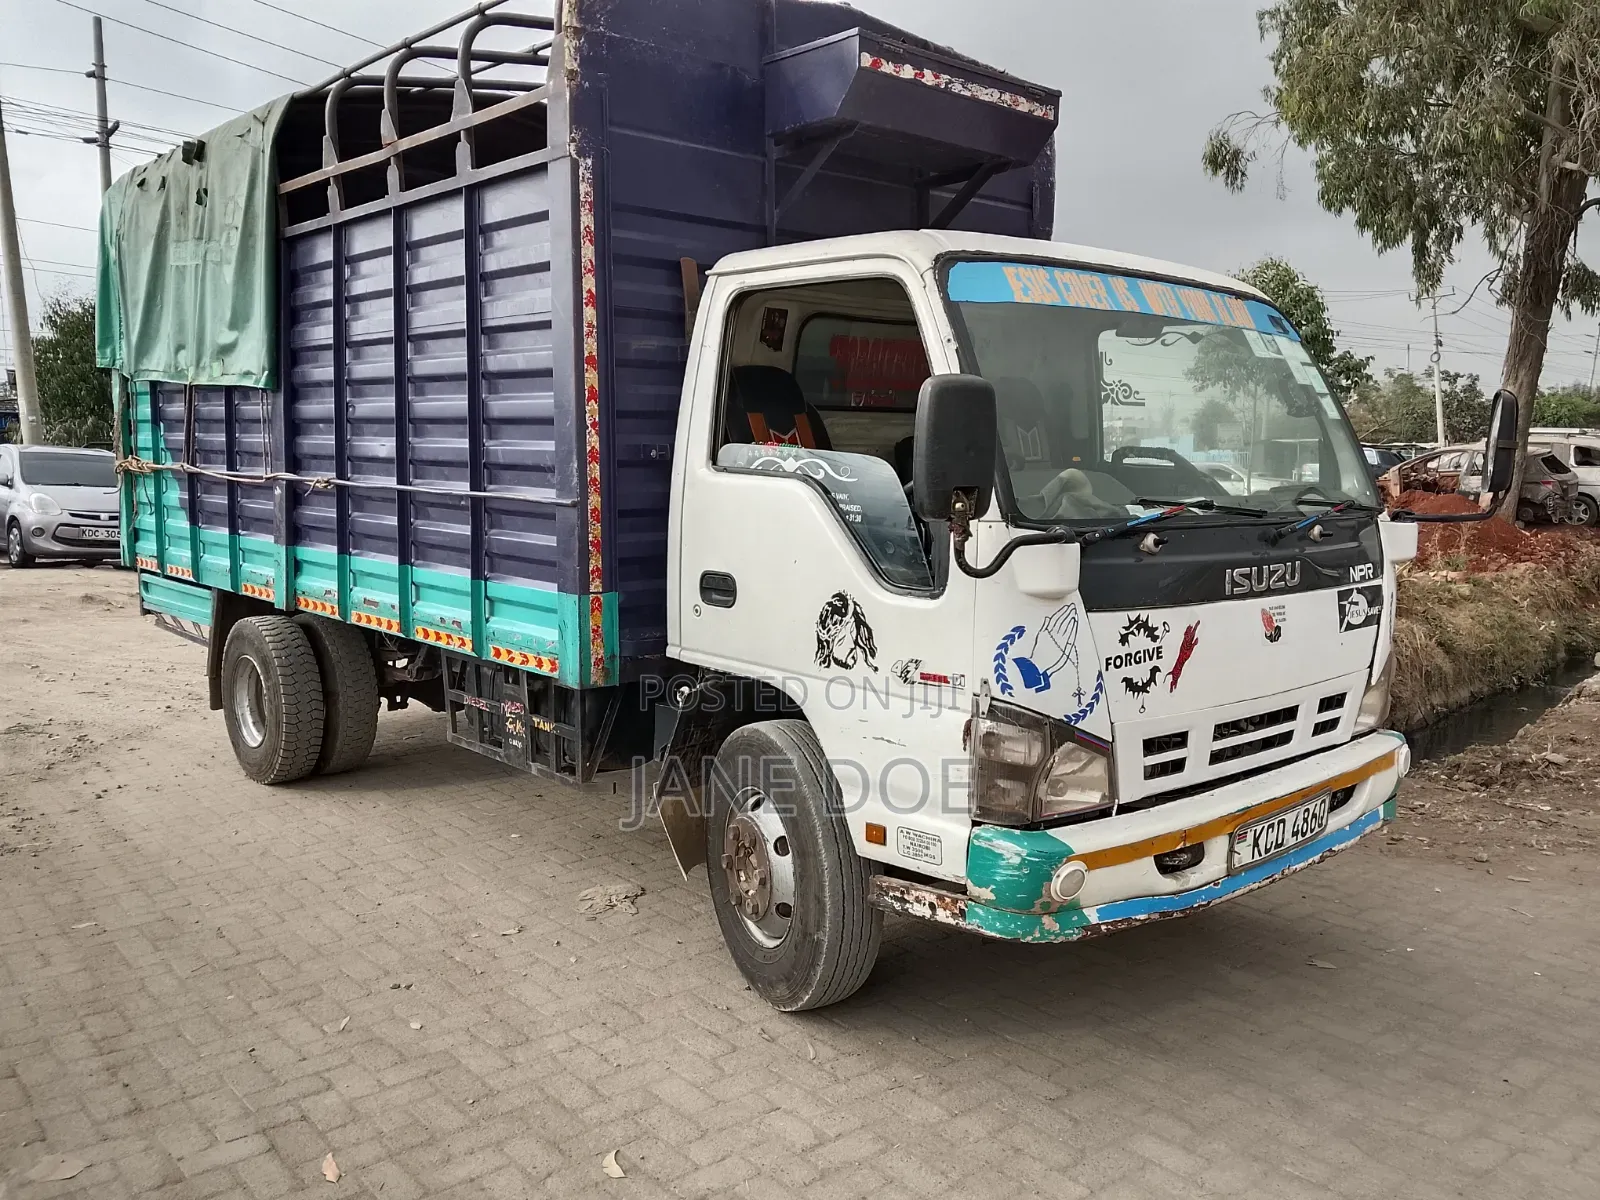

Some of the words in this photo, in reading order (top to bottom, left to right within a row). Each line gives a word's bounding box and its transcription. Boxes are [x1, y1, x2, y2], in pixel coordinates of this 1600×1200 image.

[1054, 270, 1117, 310] COVER
[81, 528, 100, 538] KDC
[1225, 561, 1300, 595] ISUZU
[1349, 563, 1374, 582] NPR
[1105, 645, 1163, 672] FORGIVE
[1251, 818, 1287, 860] KCD
